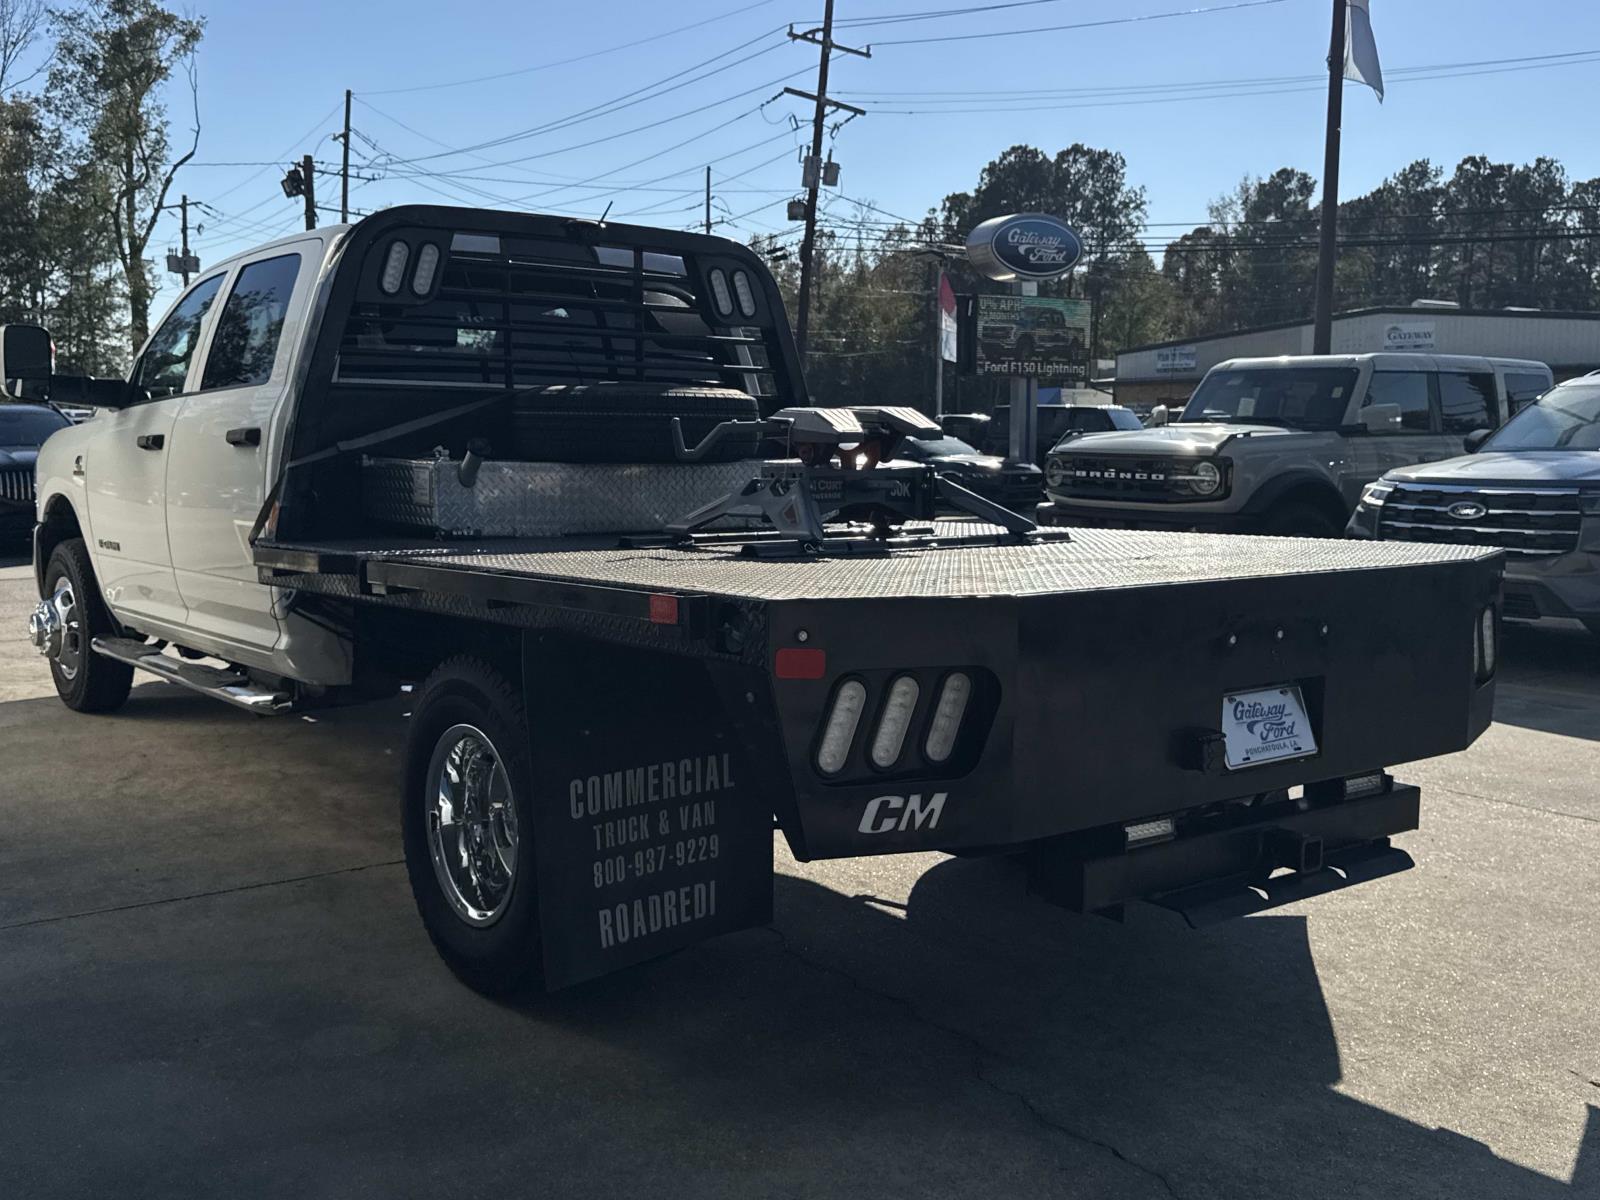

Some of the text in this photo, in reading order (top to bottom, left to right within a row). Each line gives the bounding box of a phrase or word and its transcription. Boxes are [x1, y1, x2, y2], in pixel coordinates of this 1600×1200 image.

[1008, 228, 1062, 246] Gateway
[1029, 248, 1067, 262] Ford
[984, 361, 1086, 377] Ford F150 Lightning
[817, 480, 844, 491] CURT
[1075, 470, 1165, 480] BRONCO
[1233, 700, 1286, 721] Gateway
[1260, 720, 1296, 741] Ford
[1245, 743, 1290, 756] PONCHATOULA,
[569, 753, 735, 819] COMMERCIAL
[857, 792, 949, 834] CM
[593, 801, 715, 850] TRUCK & VAN
[593, 834, 719, 888] 800-937-9229
[599, 880, 716, 949] ROADREDI
